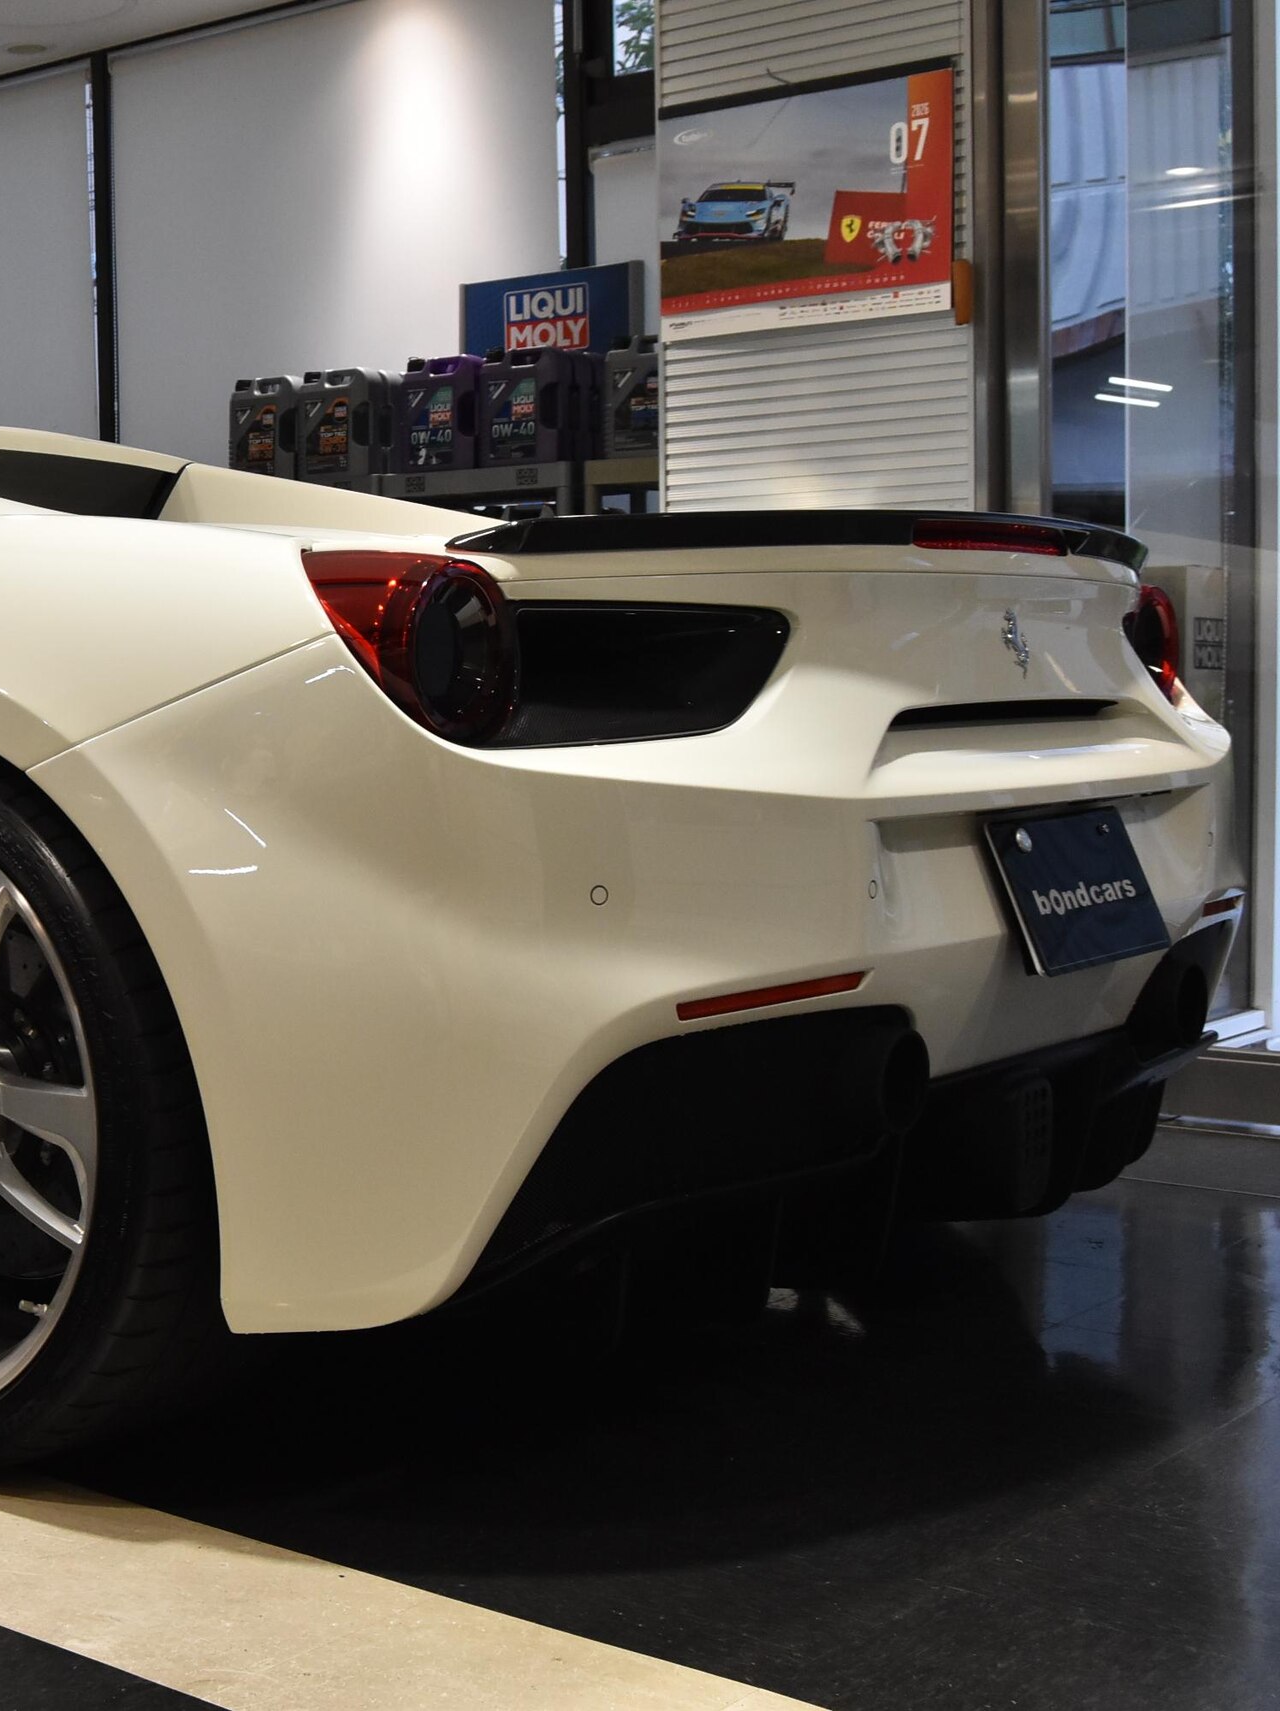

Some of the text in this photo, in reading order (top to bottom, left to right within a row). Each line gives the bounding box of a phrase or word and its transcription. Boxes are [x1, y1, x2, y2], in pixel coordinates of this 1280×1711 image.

[889, 118, 930, 164] 07
[509, 287, 583, 321] LIQUI
[510, 318, 586, 349] MOLY
[429, 412, 452, 422] MOLY
[511, 404, 535, 415] MOLY
[410, 429, 452, 445] 0W-40
[492, 421, 535, 438] 0W-40
[1195, 619, 1224, 641] LIQU
[1195, 646, 1224, 668] MOL
